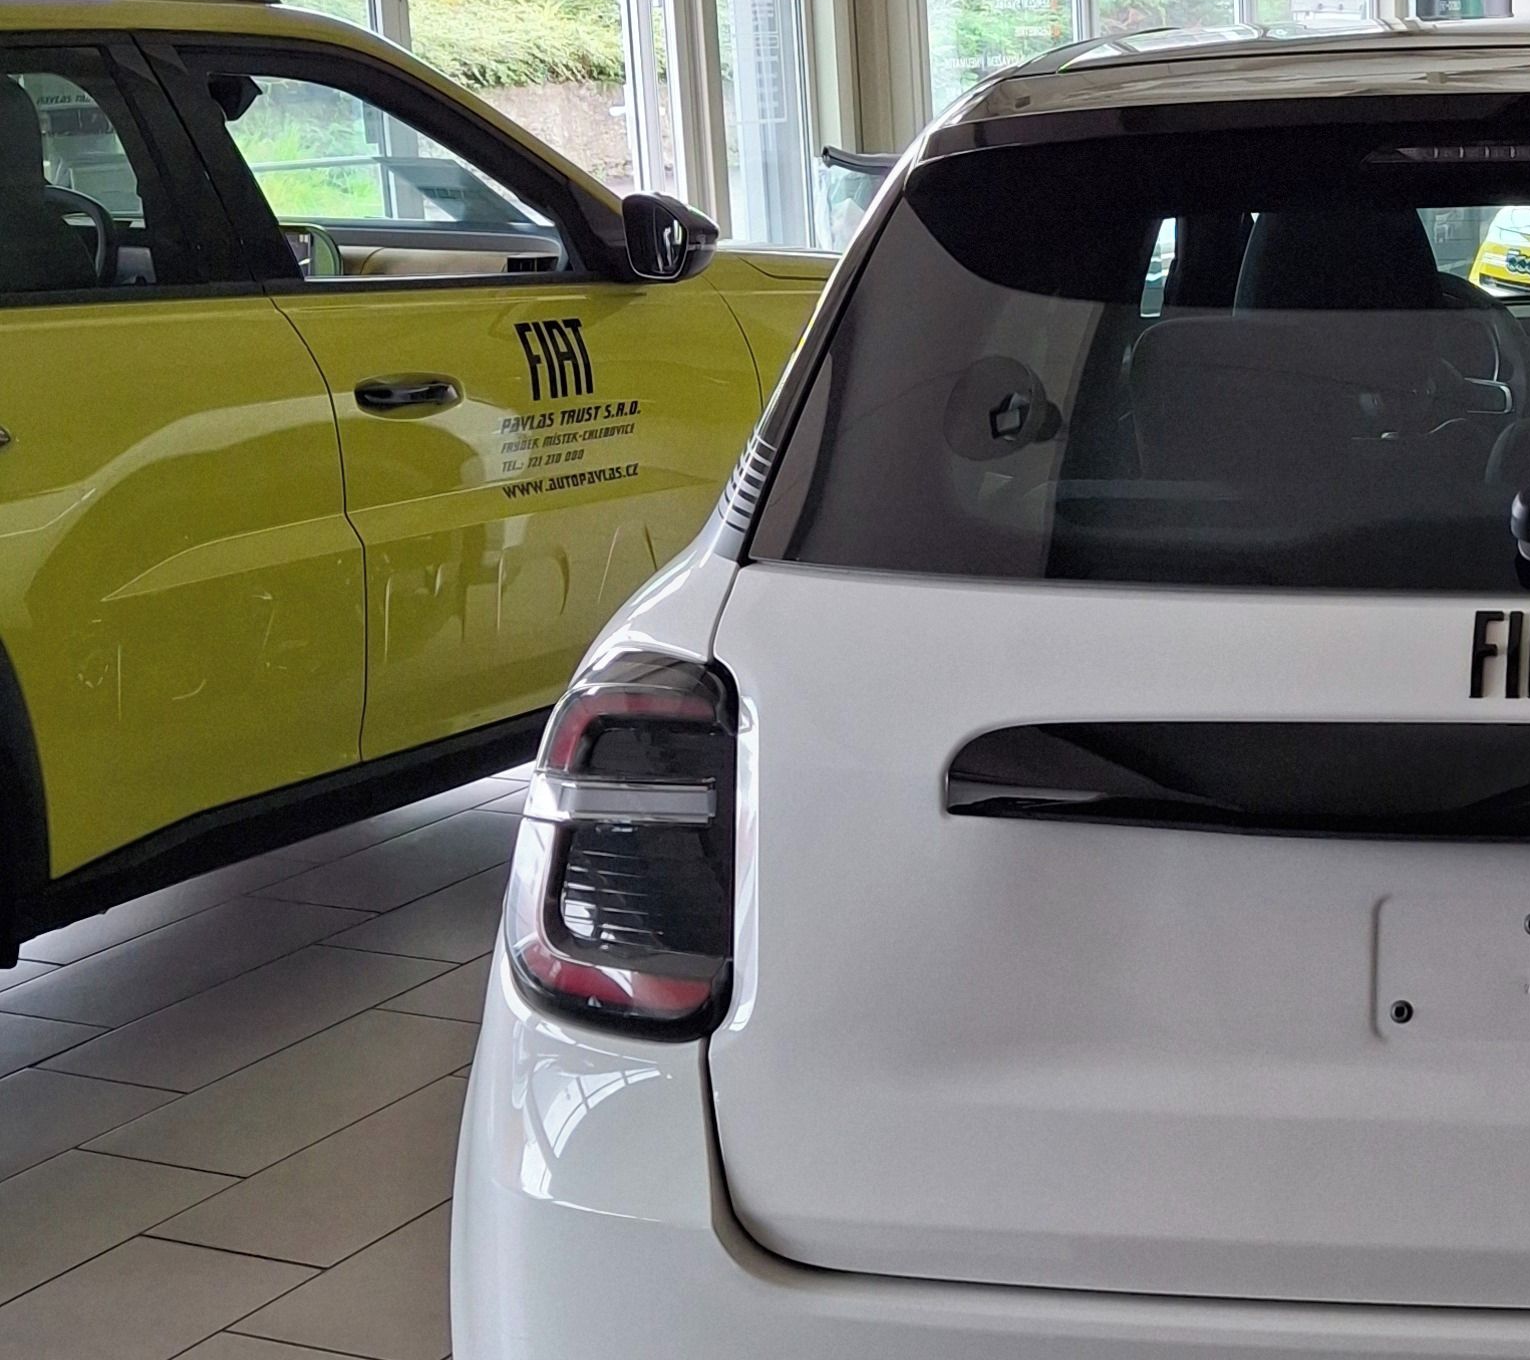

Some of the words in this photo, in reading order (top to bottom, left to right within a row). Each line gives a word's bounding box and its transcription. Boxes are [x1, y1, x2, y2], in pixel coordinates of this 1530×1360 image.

[514, 318, 594, 401] FIAT
[559, 406, 603, 427] TRUST
[603, 400, 641, 420] S.R.O.
